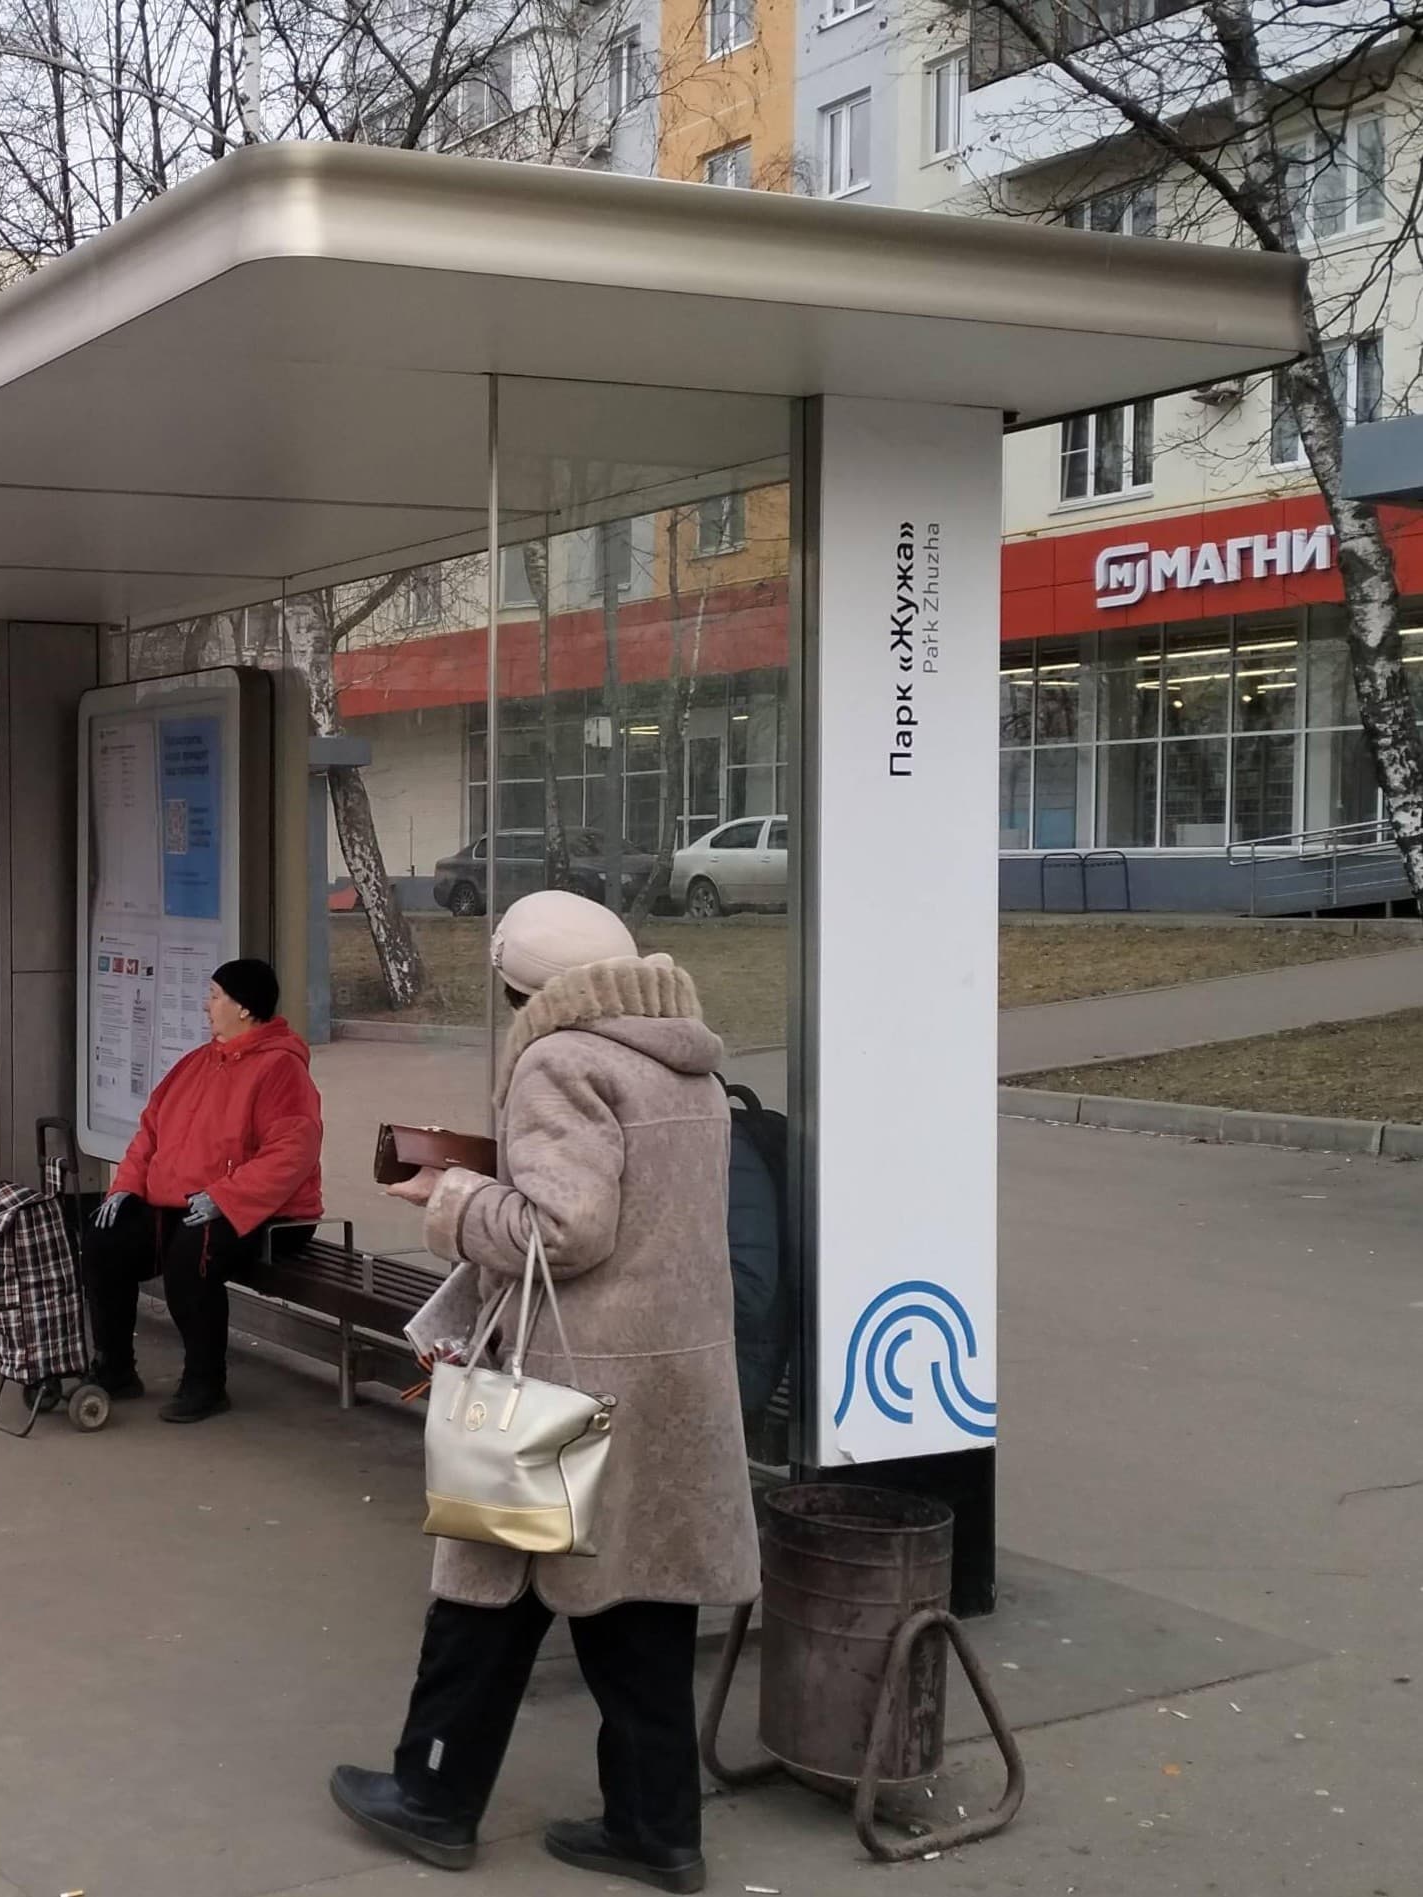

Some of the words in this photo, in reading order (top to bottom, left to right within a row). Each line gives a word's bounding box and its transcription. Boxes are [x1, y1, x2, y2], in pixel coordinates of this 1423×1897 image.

[889, 521, 920, 672] «Жужа»
[922, 522, 940, 612] Zhuzha
[1151, 524, 1336, 592] МАГНИ
[922, 619, 939, 673] Park
[889, 683, 919, 777] Парк
